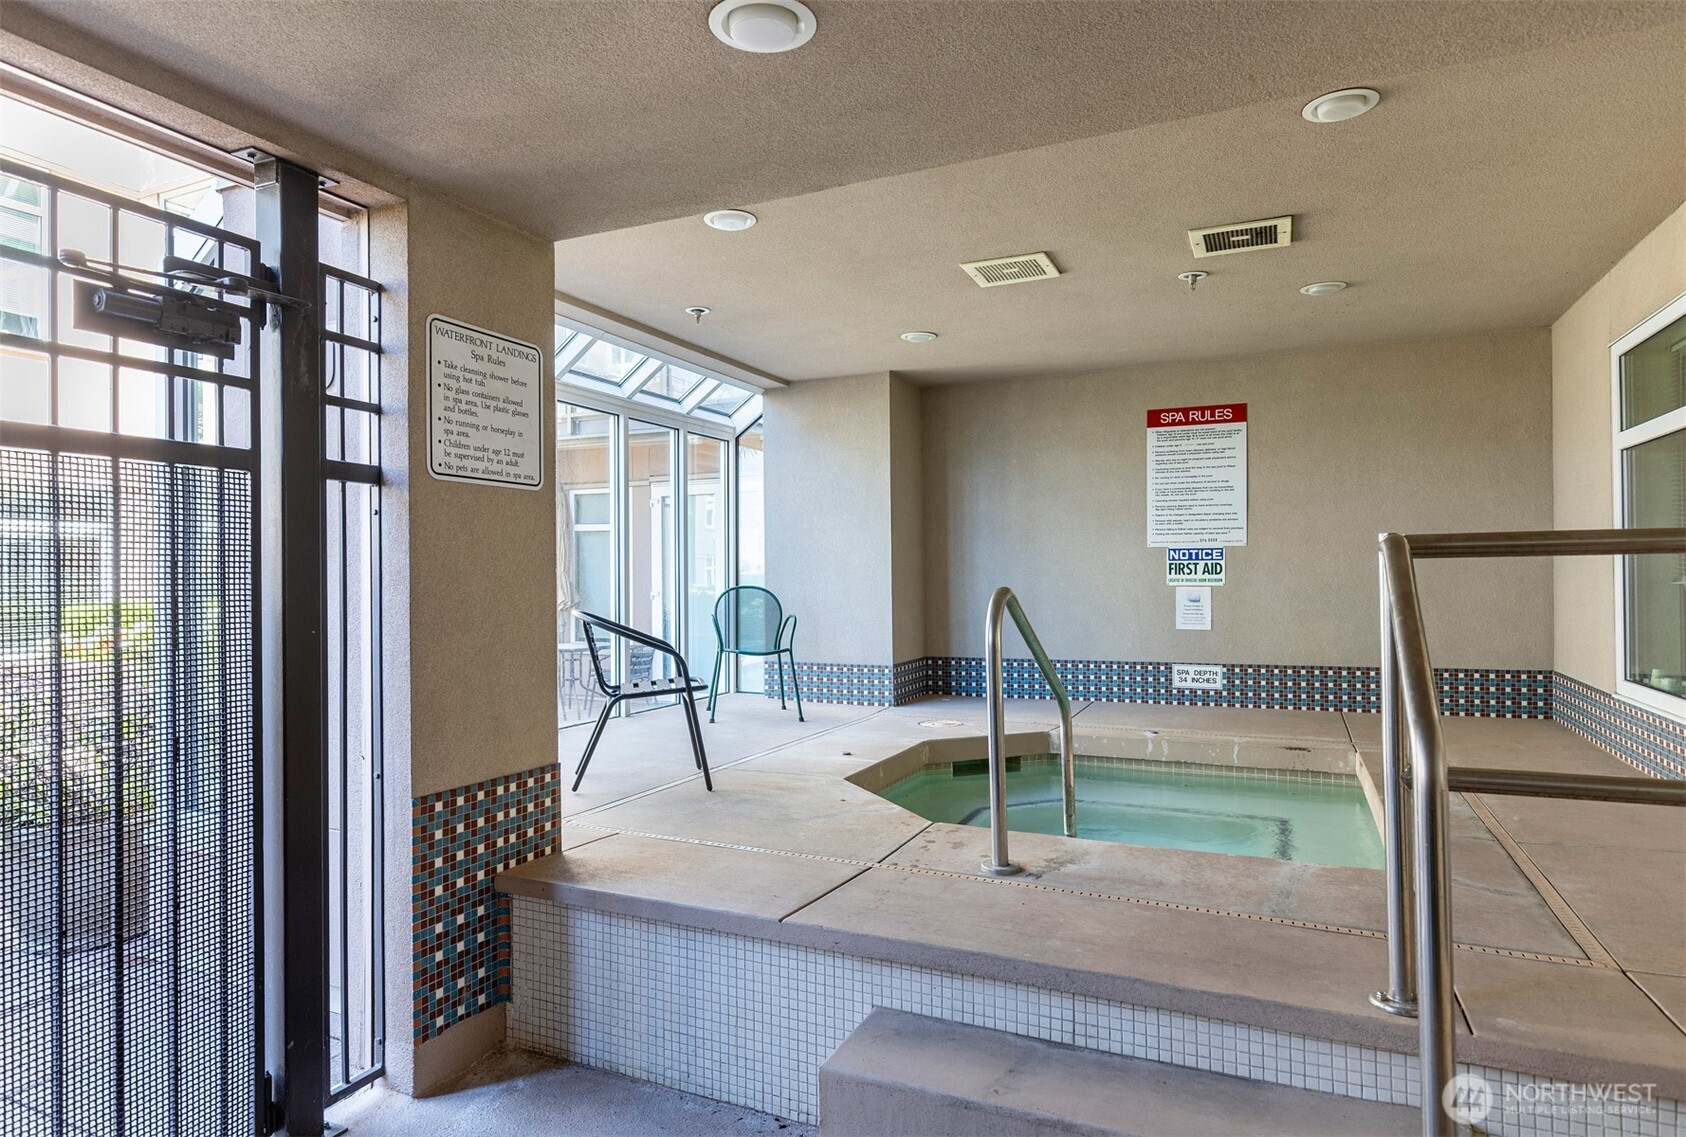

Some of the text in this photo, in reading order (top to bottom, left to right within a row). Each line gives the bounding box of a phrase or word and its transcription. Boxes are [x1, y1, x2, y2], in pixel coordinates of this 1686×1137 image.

[435, 326, 536, 363] WATERFRONT LANDINGS
[471, 350, 506, 367] Spa Rules
[443, 360, 527, 388] Take cleansing shower before
[444, 372, 486, 387] using hot tub.
[444, 383, 523, 407] No glass containers allowed
[453, 396, 462, 405] spa
[465, 399, 478, 407] area.
[481, 401, 491, 410] Use
[493, 403, 510, 414] plastic
[512, 408, 529, 418] glasses
[458, 406, 479, 417] bottles.
[1160, 409, 1233, 424] SPA RULES
[444, 416, 453, 425] No
[456, 419, 480, 432] running
[491, 424, 516, 437] horseplay
[444, 428, 453, 437] spa
[444, 439, 470, 450] Children
[473, 445, 489, 453] under
[492, 448, 502, 457] age
[504, 449, 510, 457] 12
[444, 449, 451, 457] be
[454, 452, 484, 462] supervised
[487, 457, 494, 465] by
[505, 459, 520, 467] adult.
[444, 462, 453, 470] No
[456, 465, 468, 473] pets
[482, 466, 503, 477] allowed
[513, 472, 521, 480] spa
[1169, 549, 1222, 560] NOTICE
[1168, 562, 1223, 575] FIRST AID
